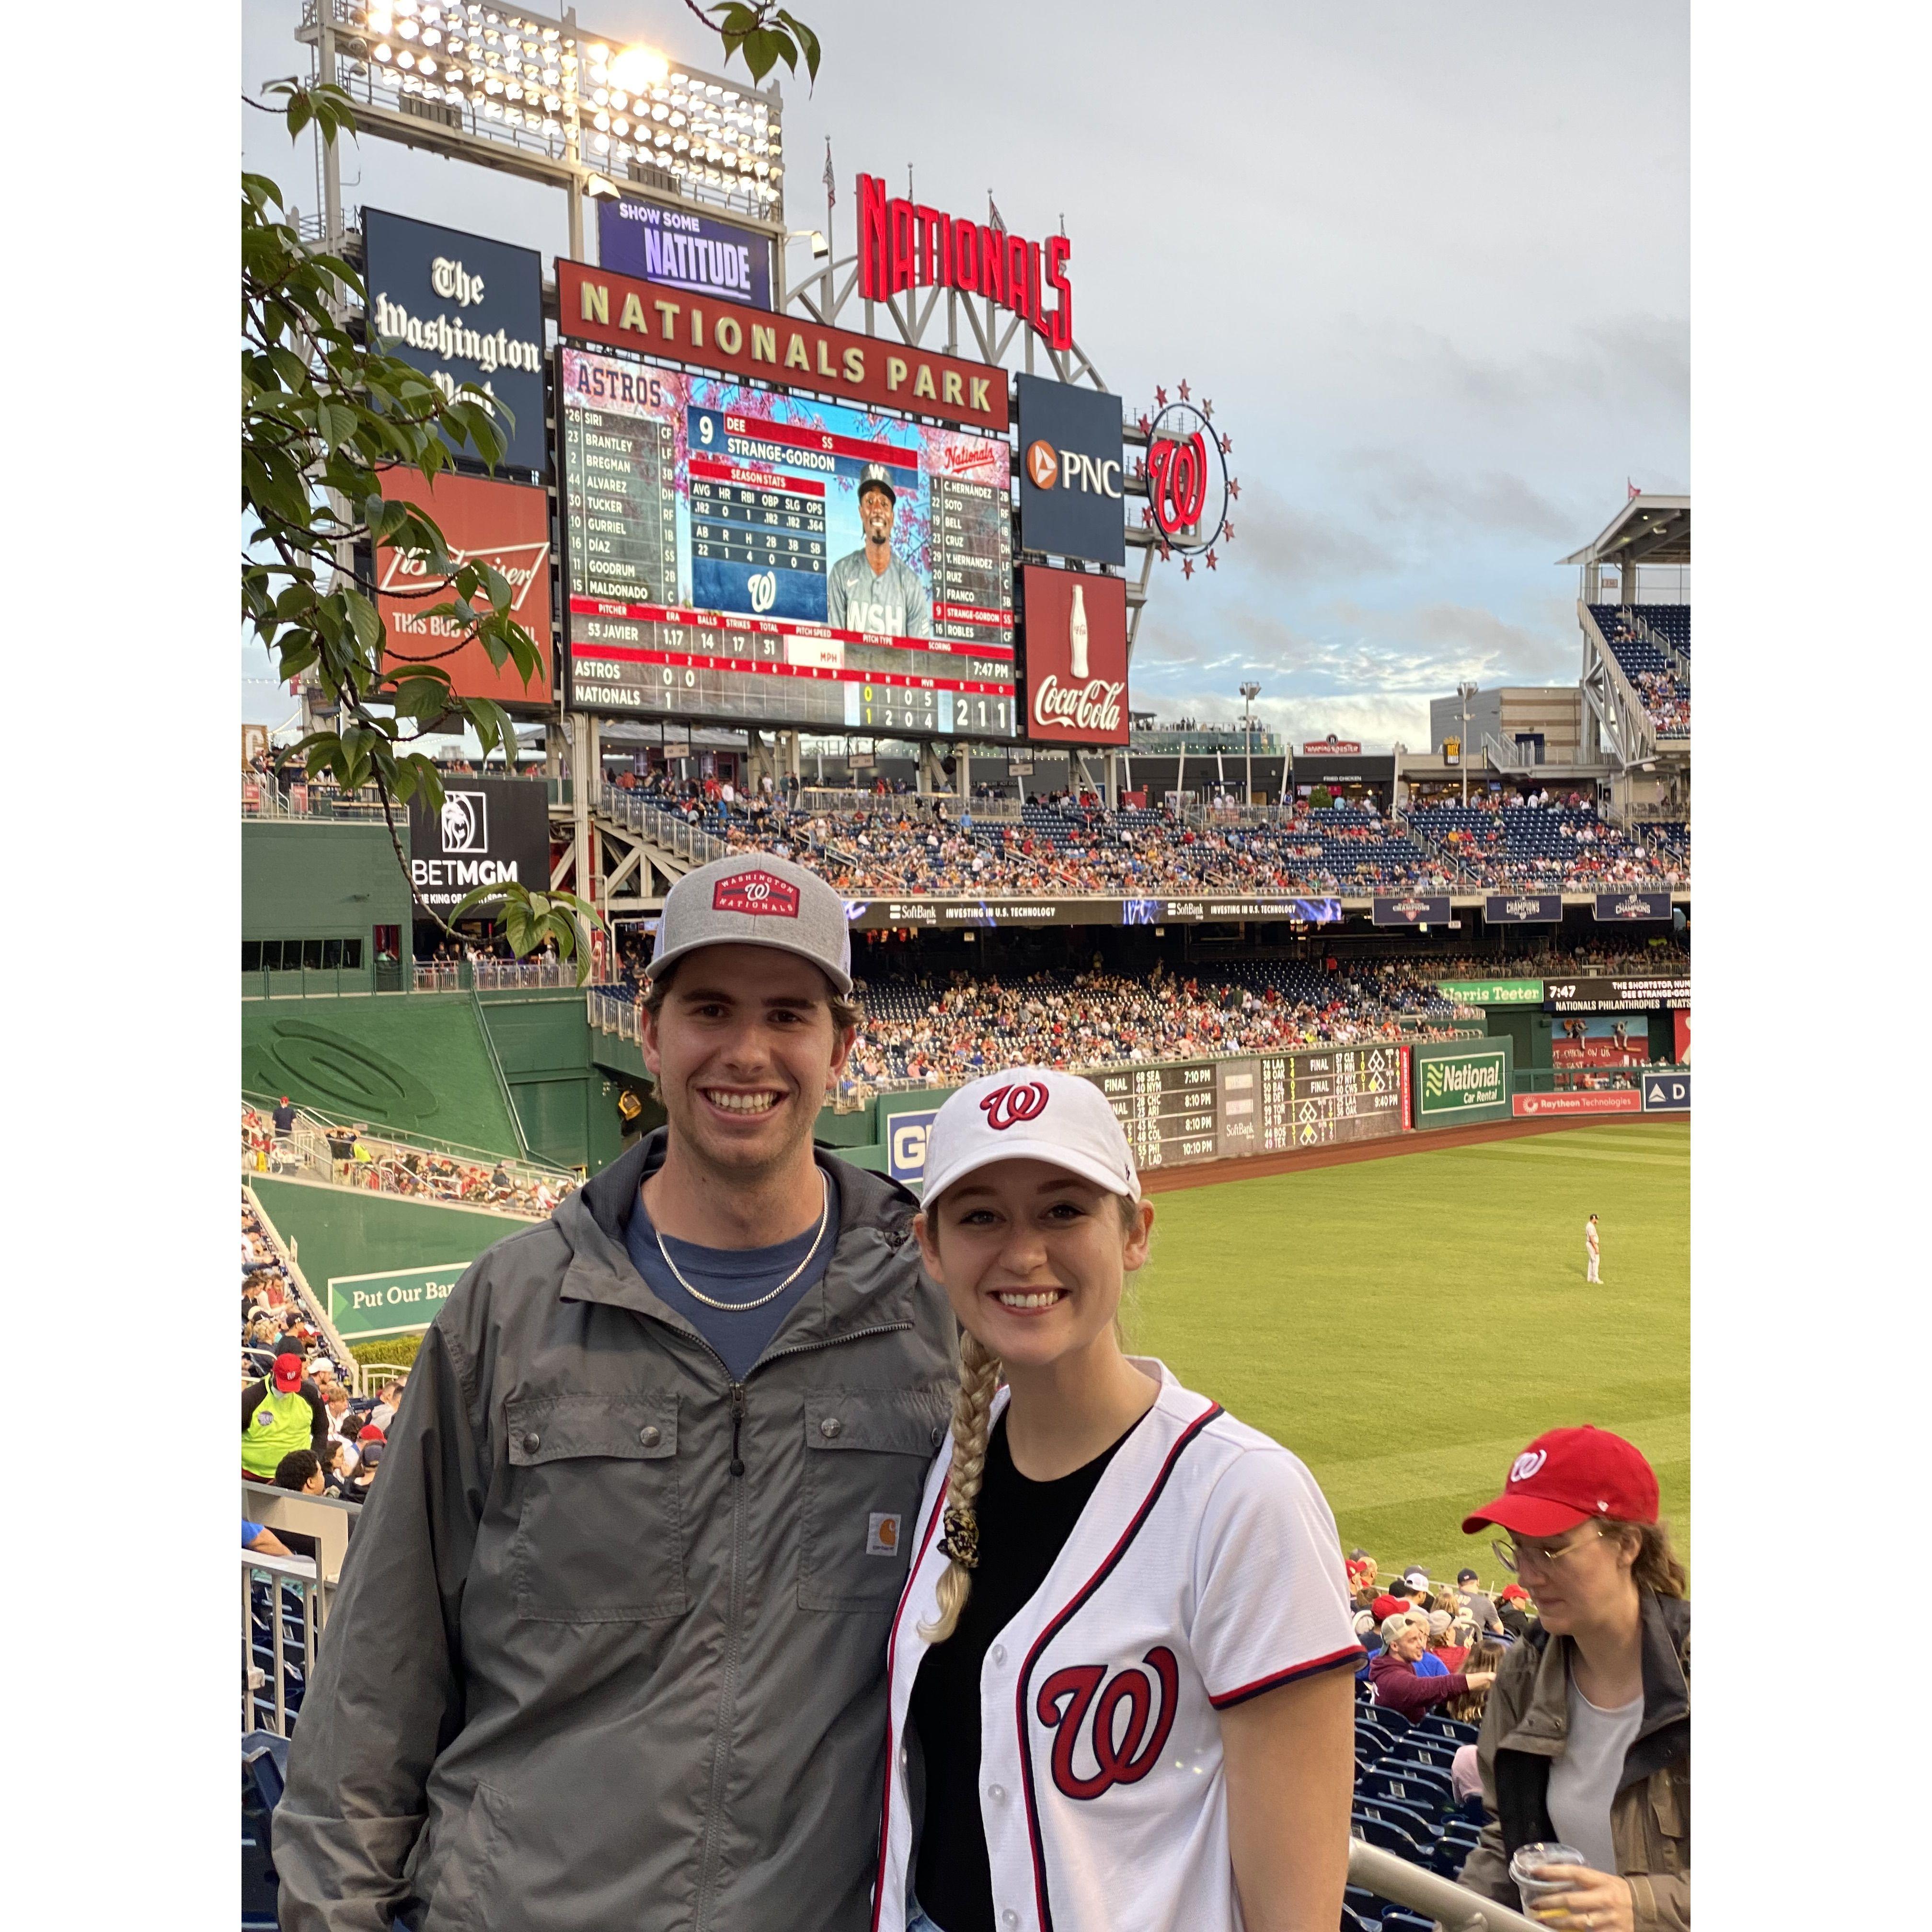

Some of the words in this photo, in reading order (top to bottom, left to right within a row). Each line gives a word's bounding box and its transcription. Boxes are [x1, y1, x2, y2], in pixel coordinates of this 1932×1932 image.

[619, 203, 660, 225] SHOW
[663, 212, 700, 232] SOME
[644, 227, 750, 290] NATITUDE
[856, 172, 1072, 351] NATIONALS
[432, 256, 484, 307] The
[374, 291, 541, 373] Washington
[581, 281, 864, 383] NATIONALS
[887, 356, 991, 413] PARK
[576, 364, 661, 408] ASTROS
[584, 415, 602, 427] SIRI
[699, 415, 713, 444] 9
[727, 417, 746, 432] DEE
[822, 436, 833, 449] SS
[567, 432, 578, 444] 23
[586, 433, 632, 453] BRANTLEY
[571, 452, 576, 464] 2
[586, 455, 630, 473] BREGMAN
[727, 439, 835, 472] STRANGE-GORDON
[944, 442, 995, 472] Nationals
[731, 469, 762, 485] SEASON
[763, 473, 786, 488] STATS
[1058, 449, 1122, 498] PNC
[568, 473, 580, 486] 44
[587, 476, 627, 494] ALVAREZ
[944, 481, 951, 492] C.
[1149, 432, 1207, 533] W
[569, 494, 580, 507] 30
[587, 496, 622, 514] TUCKER
[693, 483, 711, 496] AVG
[719, 487, 731, 500] HR
[741, 490, 755, 504] RBI
[762, 493, 779, 507] OBP
[785, 497, 800, 511] SLG
[806, 501, 823, 515] OPS
[944, 499, 962, 511] SOTO
[570, 515, 580, 528] 10
[588, 518, 626, 535] GURRIEL
[696, 525, 708, 538] AB
[945, 517, 962, 529] BELL
[571, 536, 581, 549] 16
[588, 537, 610, 553] DÍAZ
[698, 543, 708, 556] 22
[945, 534, 964, 548] CRUZ
[946, 552, 952, 564] Y.
[574, 557, 581, 571] 11
[589, 560, 635, 577] GOODRUM
[946, 571, 962, 583] RUIZ
[573, 579, 582, 592] 15
[589, 580, 648, 599] MALDONADO
[748, 571, 776, 613] W
[947, 588, 974, 602] FRANCO
[392, 612, 426, 634] THIS
[598, 604, 627, 615] PITCHER
[666, 611, 680, 622] ERA
[697, 614, 717, 626] BALLS
[726, 618, 751, 630] STRIKES
[759, 621, 778, 632] TOTAL
[796, 626, 813, 636] PITCH
[814, 627, 832, 638] SPEED
[847, 601, 903, 637] WSH
[947, 608, 999, 622] STRANGE-GORDON
[948, 624, 974, 638] ROBLES
[602, 623, 638, 641] JAVIER
[664, 628, 683, 646] 1.17
[702, 633, 714, 649] 14
[733, 636, 744, 652] 17
[764, 639, 775, 655] 31
[820, 652, 837, 663] MPH
[973, 662, 993, 676] 7:47
[995, 664, 1008, 678] PM
[575, 660, 621, 679] ASTROS
[575, 686, 640, 705] NATIONALS
[1034, 674, 1125, 731] Coca-Cola
[957, 700, 968, 726] 2
[412, 860, 518, 886] BETMGM
[721, 874, 794, 894] WASHINGTON
[744, 882, 770, 901] W
[430, 893, 450, 904] KING
[719, 897, 793, 912] NATIONALS
[901, 905, 936, 919] SoftBank
[945, 908, 983, 918] INVESTING
[985, 908, 993, 918] IN
[995, 908, 1009, 918] U.S.
[1011, 907, 1056, 917] TECHNOLOGY
[1177, 903, 1203, 915] SoftBank
[1211, 905, 1240, 914] INVESTING
[1242, 905, 1247, 914] IN
[1249, 905, 1260, 914] U.S.
[1261, 905, 1296, 913] TECHNOLOGY
[1506, 900, 1540, 916] CHAMPIONS
[1616, 904, 1650, 914] CHAMPIONS
[1493, 986, 1539, 1000] Teeter
[1550, 985, 1576, 998] 7:47
[1612, 981, 1627, 990] THE
[1622, 990, 1636, 999] DEE
[1638, 989, 1690, 998] STRANGE-GOR
[1556, 1000, 1596, 1012] NATIONALS
[1598, 999, 1660, 1010] PHILANTHROPIES
[1272, 1059, 1284, 1070] LAA
[1310, 1058, 1329, 1071] FINAL
[1344, 1052, 1354, 1062] CLE
[1147, 1070, 1160, 1081] SEA
[1184, 1070, 1198, 1084] 7:10
[1200, 1070, 1210, 1081] PM
[1272, 1069, 1285, 1080] OAK
[1104, 1078, 1127, 1092] FINAL
[1147, 1081, 1161, 1092] NYM
[1273, 1081, 1284, 1092] BAL
[1311, 1080, 1329, 1093] FINAL
[1147, 1094, 1161, 1106] CHC
[1185, 1093, 1198, 1107] 8:10
[1201, 1092, 1211, 1105] PM
[1375, 1096, 1388, 1107] 9:40
[1389, 1094, 1398, 1106] PM
[1464, 1092, 1475, 1104] Car
[1477, 1089, 1497, 1102] Rental
[1541, 1099, 1580, 1109] Raytheon
[1582, 1097, 1631, 1107] Technologies
[979, 1081, 1050, 1131] W
[1148, 1105, 1159, 1116] ARI
[1273, 1104, 1285, 1115] TOR
[1148, 1119, 1156, 1130] KC
[1185, 1117, 1199, 1131] 8:10
[1201, 1116, 1211, 1128] PM
[1227, 1123, 1254, 1137] SoftBank
[1149, 1143, 1159, 1154] PHI
[1183, 1141, 1200, 1155] 10:10
[1202, 1140, 1212, 1152] PM
[1149, 1153, 1162, 1165] LAD
[353, 1290, 383, 1309] Put
[387, 1286, 422, 1304] Our
[1036, 1645, 1179, 1801] W
